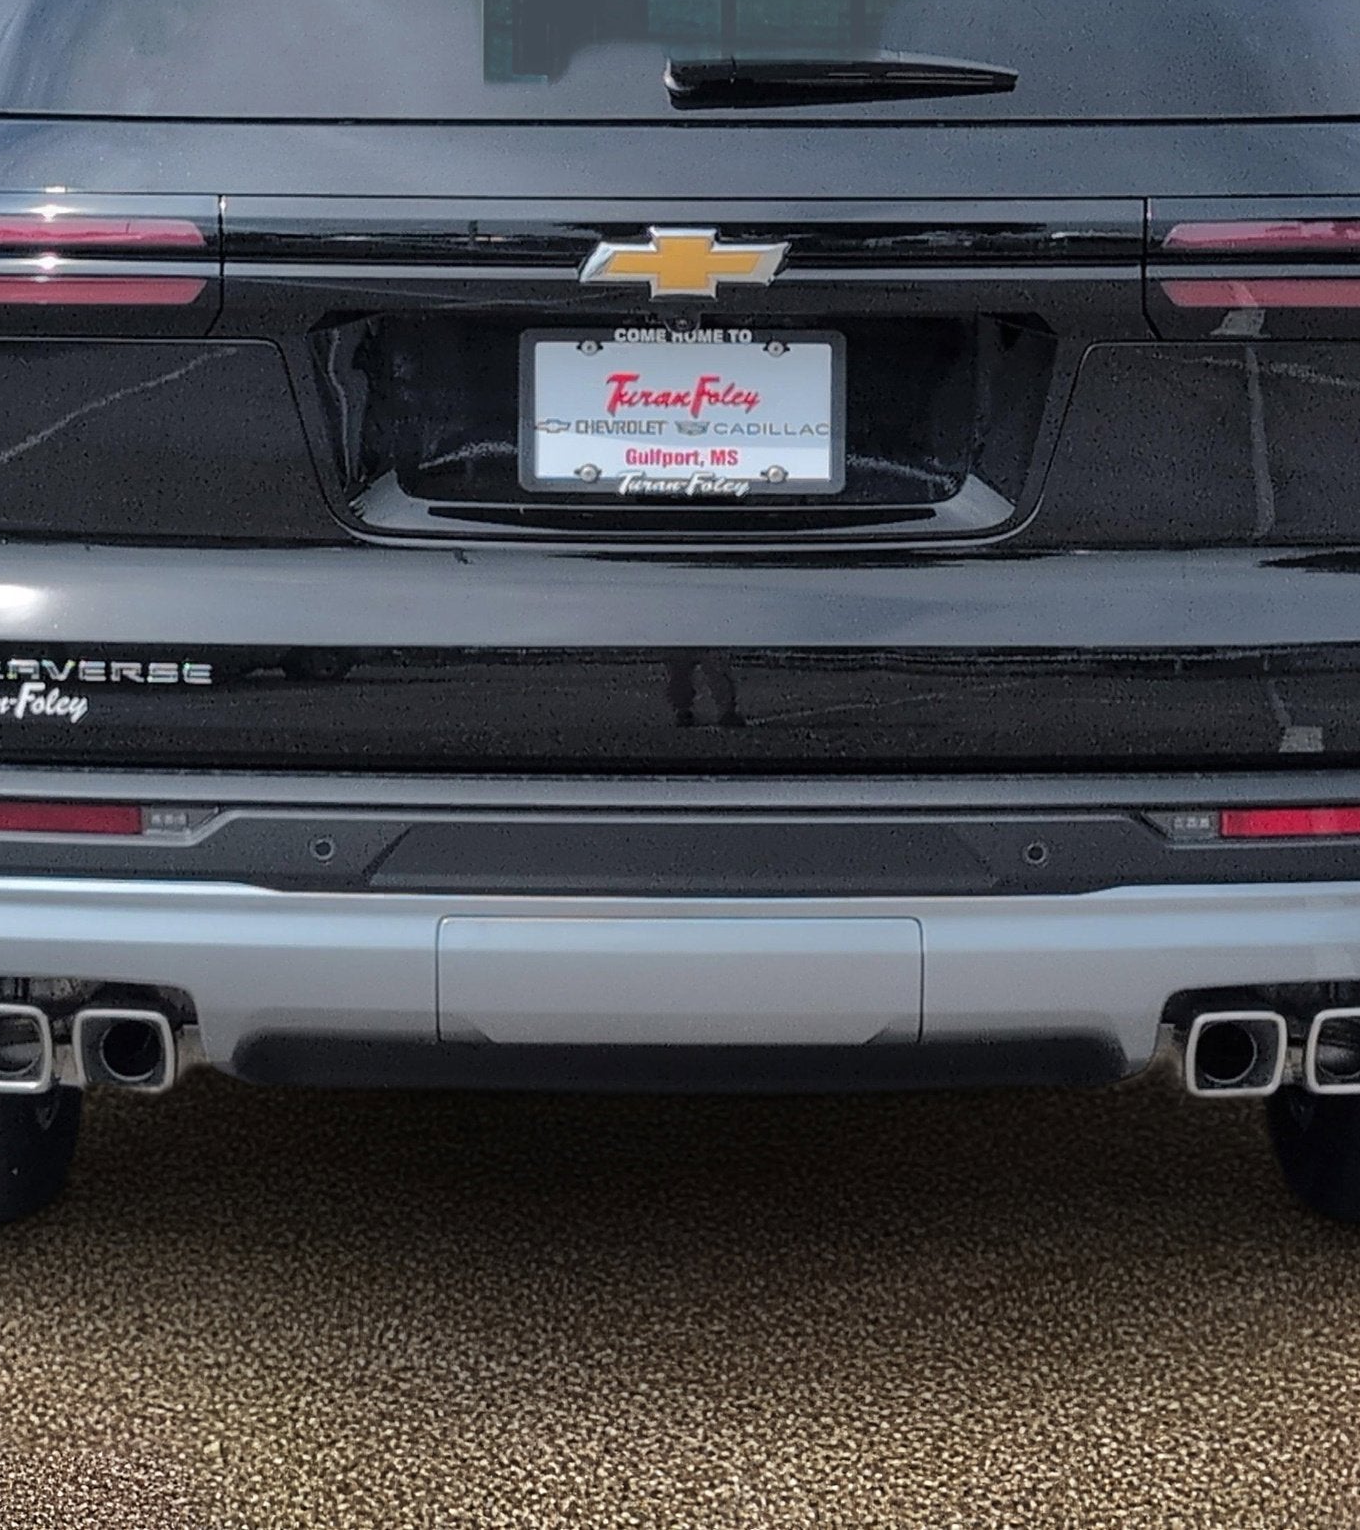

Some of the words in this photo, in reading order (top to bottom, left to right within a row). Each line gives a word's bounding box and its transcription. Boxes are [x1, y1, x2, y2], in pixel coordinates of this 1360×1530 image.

[614, 328, 666, 343] COME
[671, 328, 723, 343] HOME
[728, 329, 753, 343] TO
[575, 420, 669, 436] CHEVROLET
[713, 422, 830, 436] CADILLAC
[625, 448, 706, 467] Gulfport,
[710, 449, 739, 466] MS
